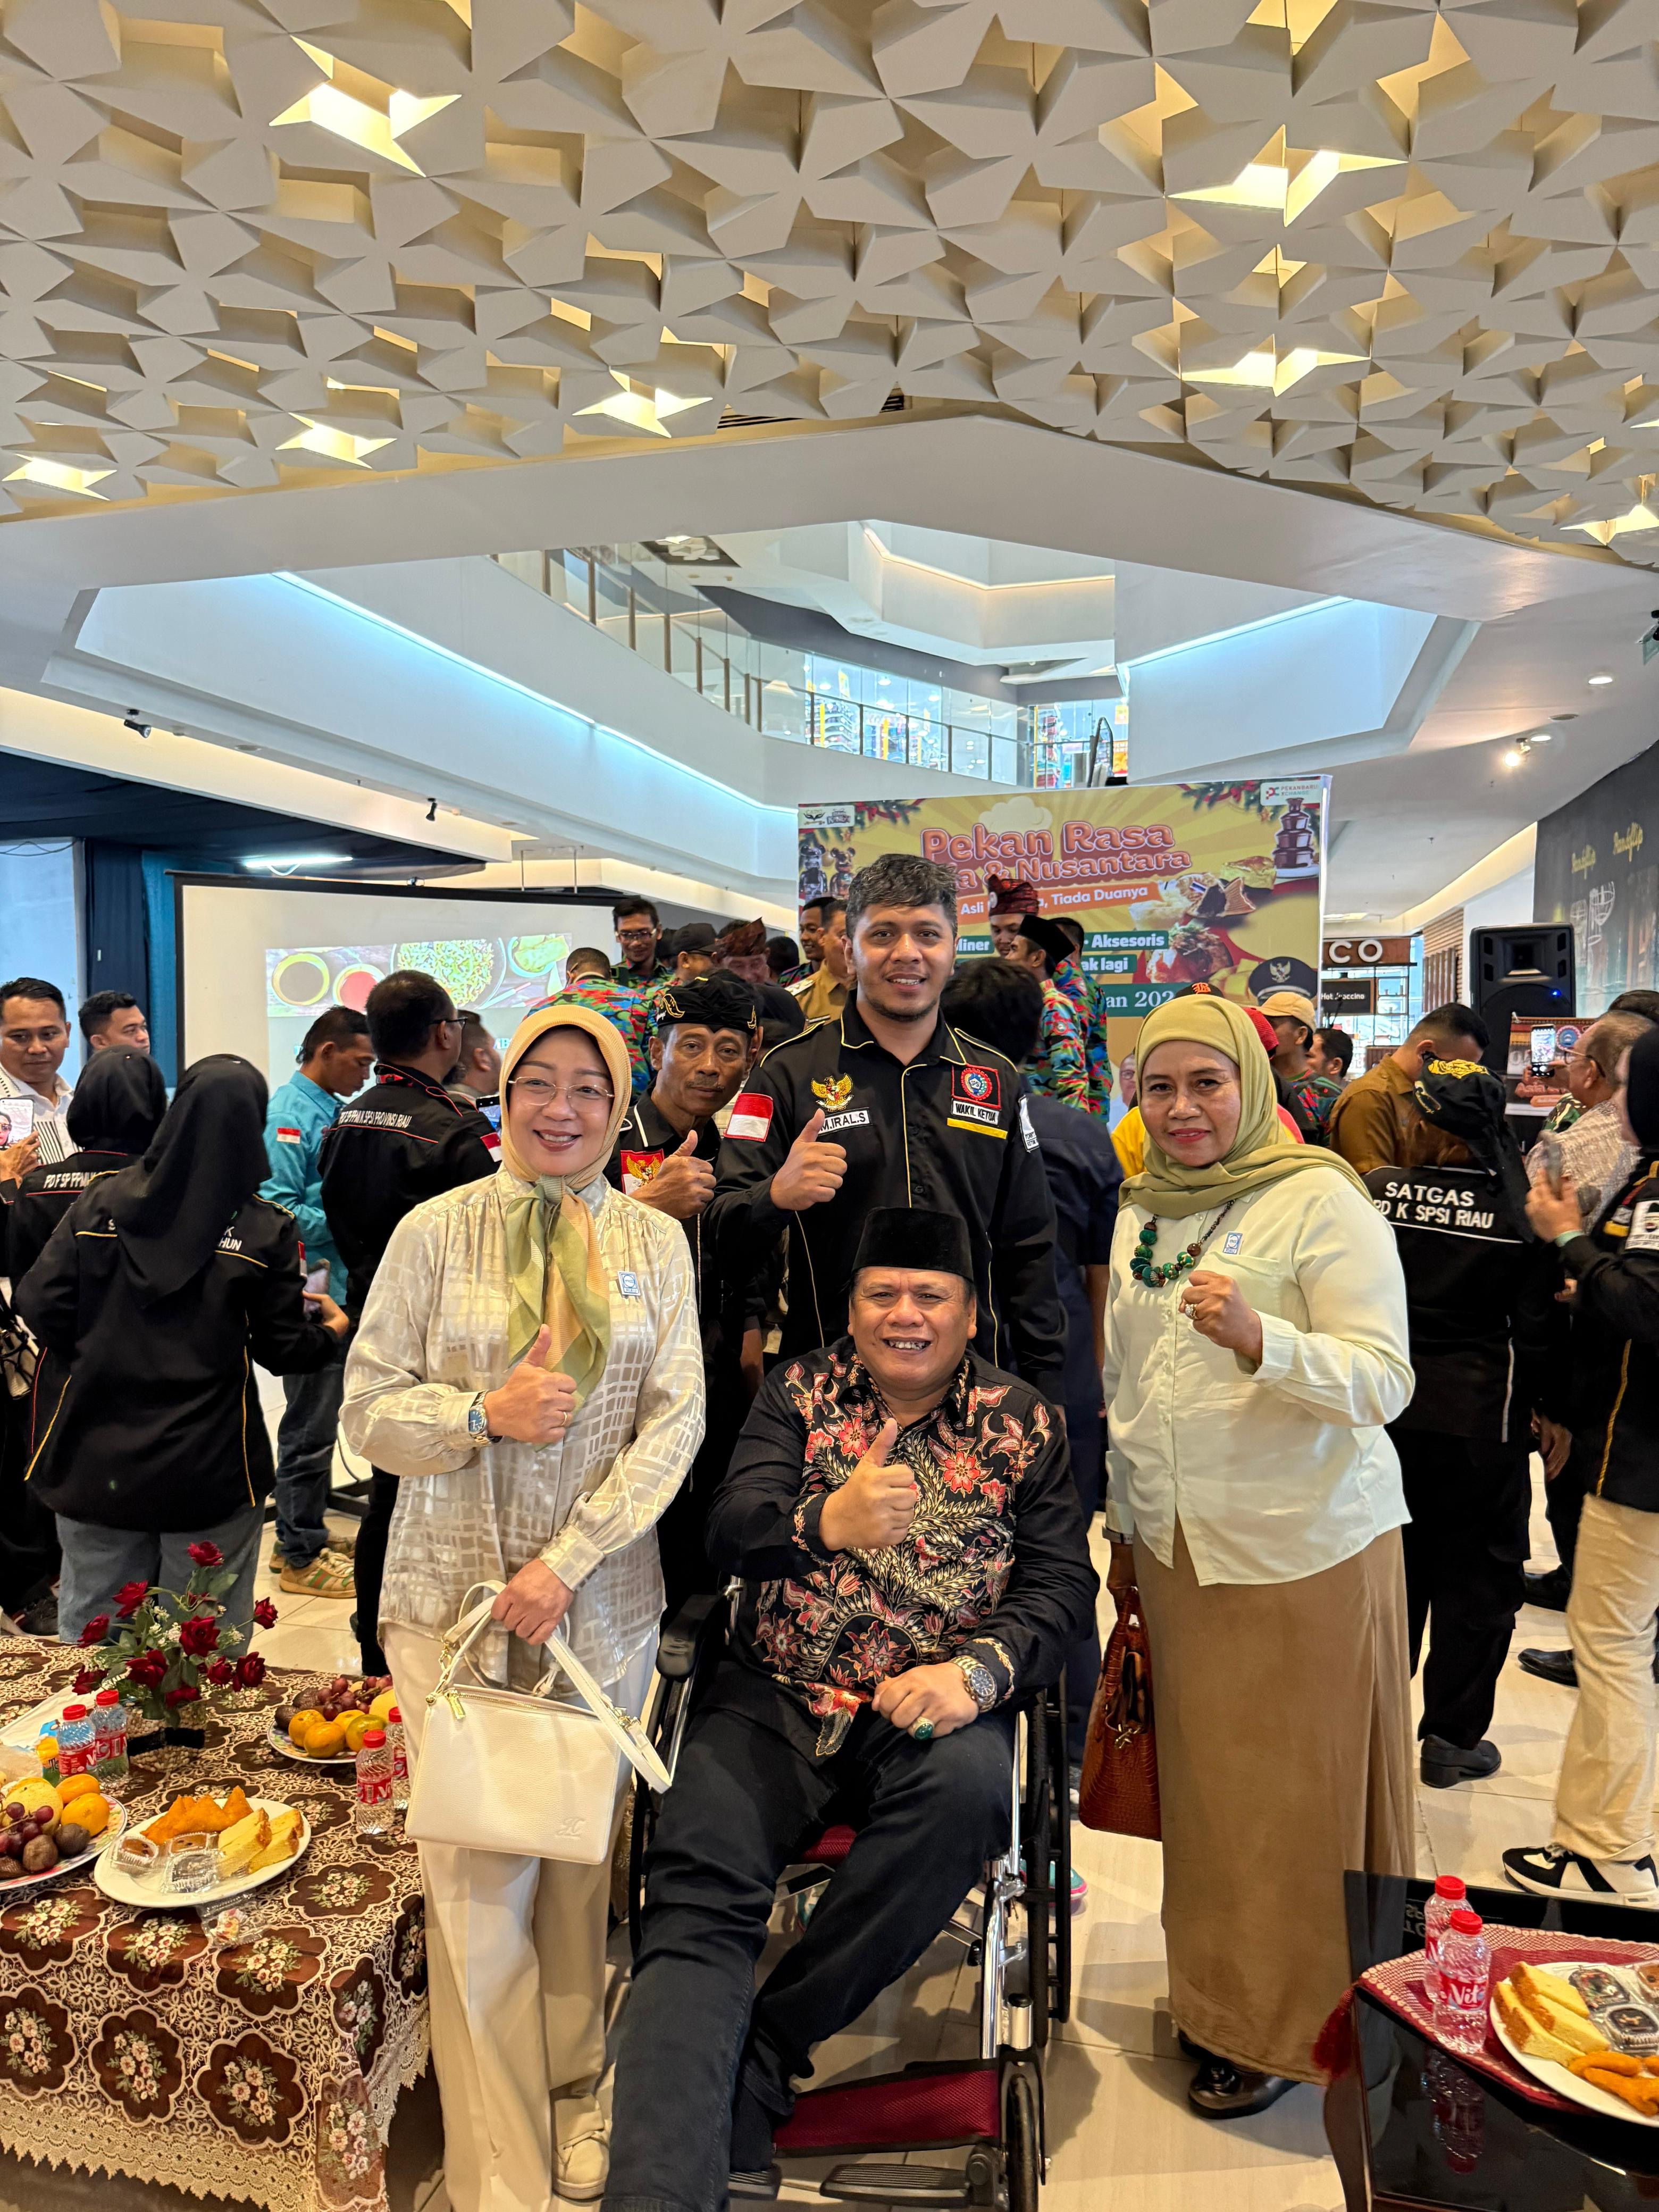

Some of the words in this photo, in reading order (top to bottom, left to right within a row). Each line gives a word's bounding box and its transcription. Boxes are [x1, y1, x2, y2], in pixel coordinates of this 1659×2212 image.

[920, 823, 1053, 861] Pekan
[1062, 821, 1175, 852] Rasa
[1015, 851, 1192, 882] Nusantara
[961, 901, 984, 915] Asli
[1051, 892, 1091, 906] Tiada
[1094, 886, 1148, 904] Duanya
[957, 939, 990, 951] liner
[1092, 933, 1164, 948] Aksesoris
[1100, 957, 1128, 973] lagi
[1134, 991, 1175, 1007] 202
[396, 1114, 412, 1128] RIAU
[956, 1103, 976, 1116] WAKIL
[978, 1109, 996, 1122] KETUA
[1385, 1182, 1474, 1206] SATGAS
[1396, 1202, 1409, 1219] K
[1415, 1204, 1451, 1225] SPSI
[1455, 1210, 1494, 1229] RIAU
[218, 1237, 242, 1251] HUN
[1450, 1983, 1478, 2005] Vit
